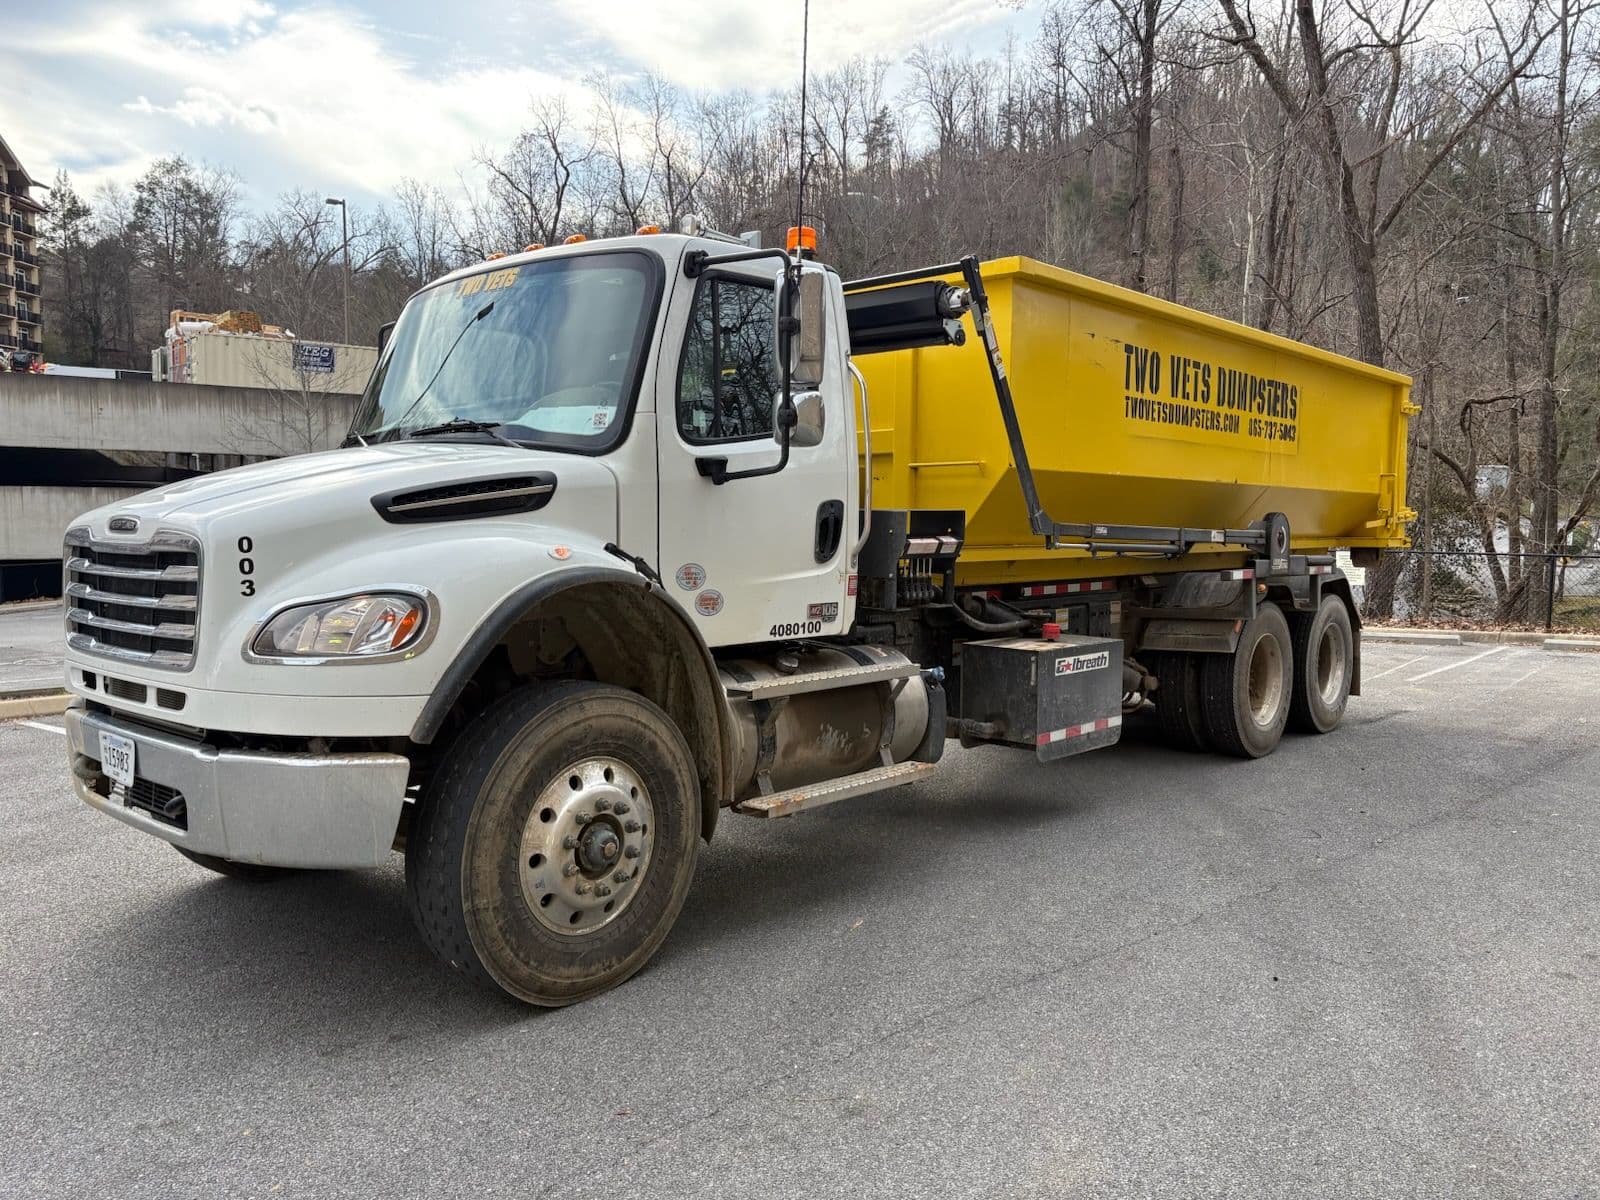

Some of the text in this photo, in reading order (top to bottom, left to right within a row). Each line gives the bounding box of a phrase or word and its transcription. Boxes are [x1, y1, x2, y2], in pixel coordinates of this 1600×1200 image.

[1124, 343, 1298, 421] TWO VETS DUMPSTERS
[1125, 396, 1240, 434] TWOVETSDUMPSTERS.COM
[769, 621, 822, 638] 4080100
[1056, 653, 1107, 674] Glbreath
